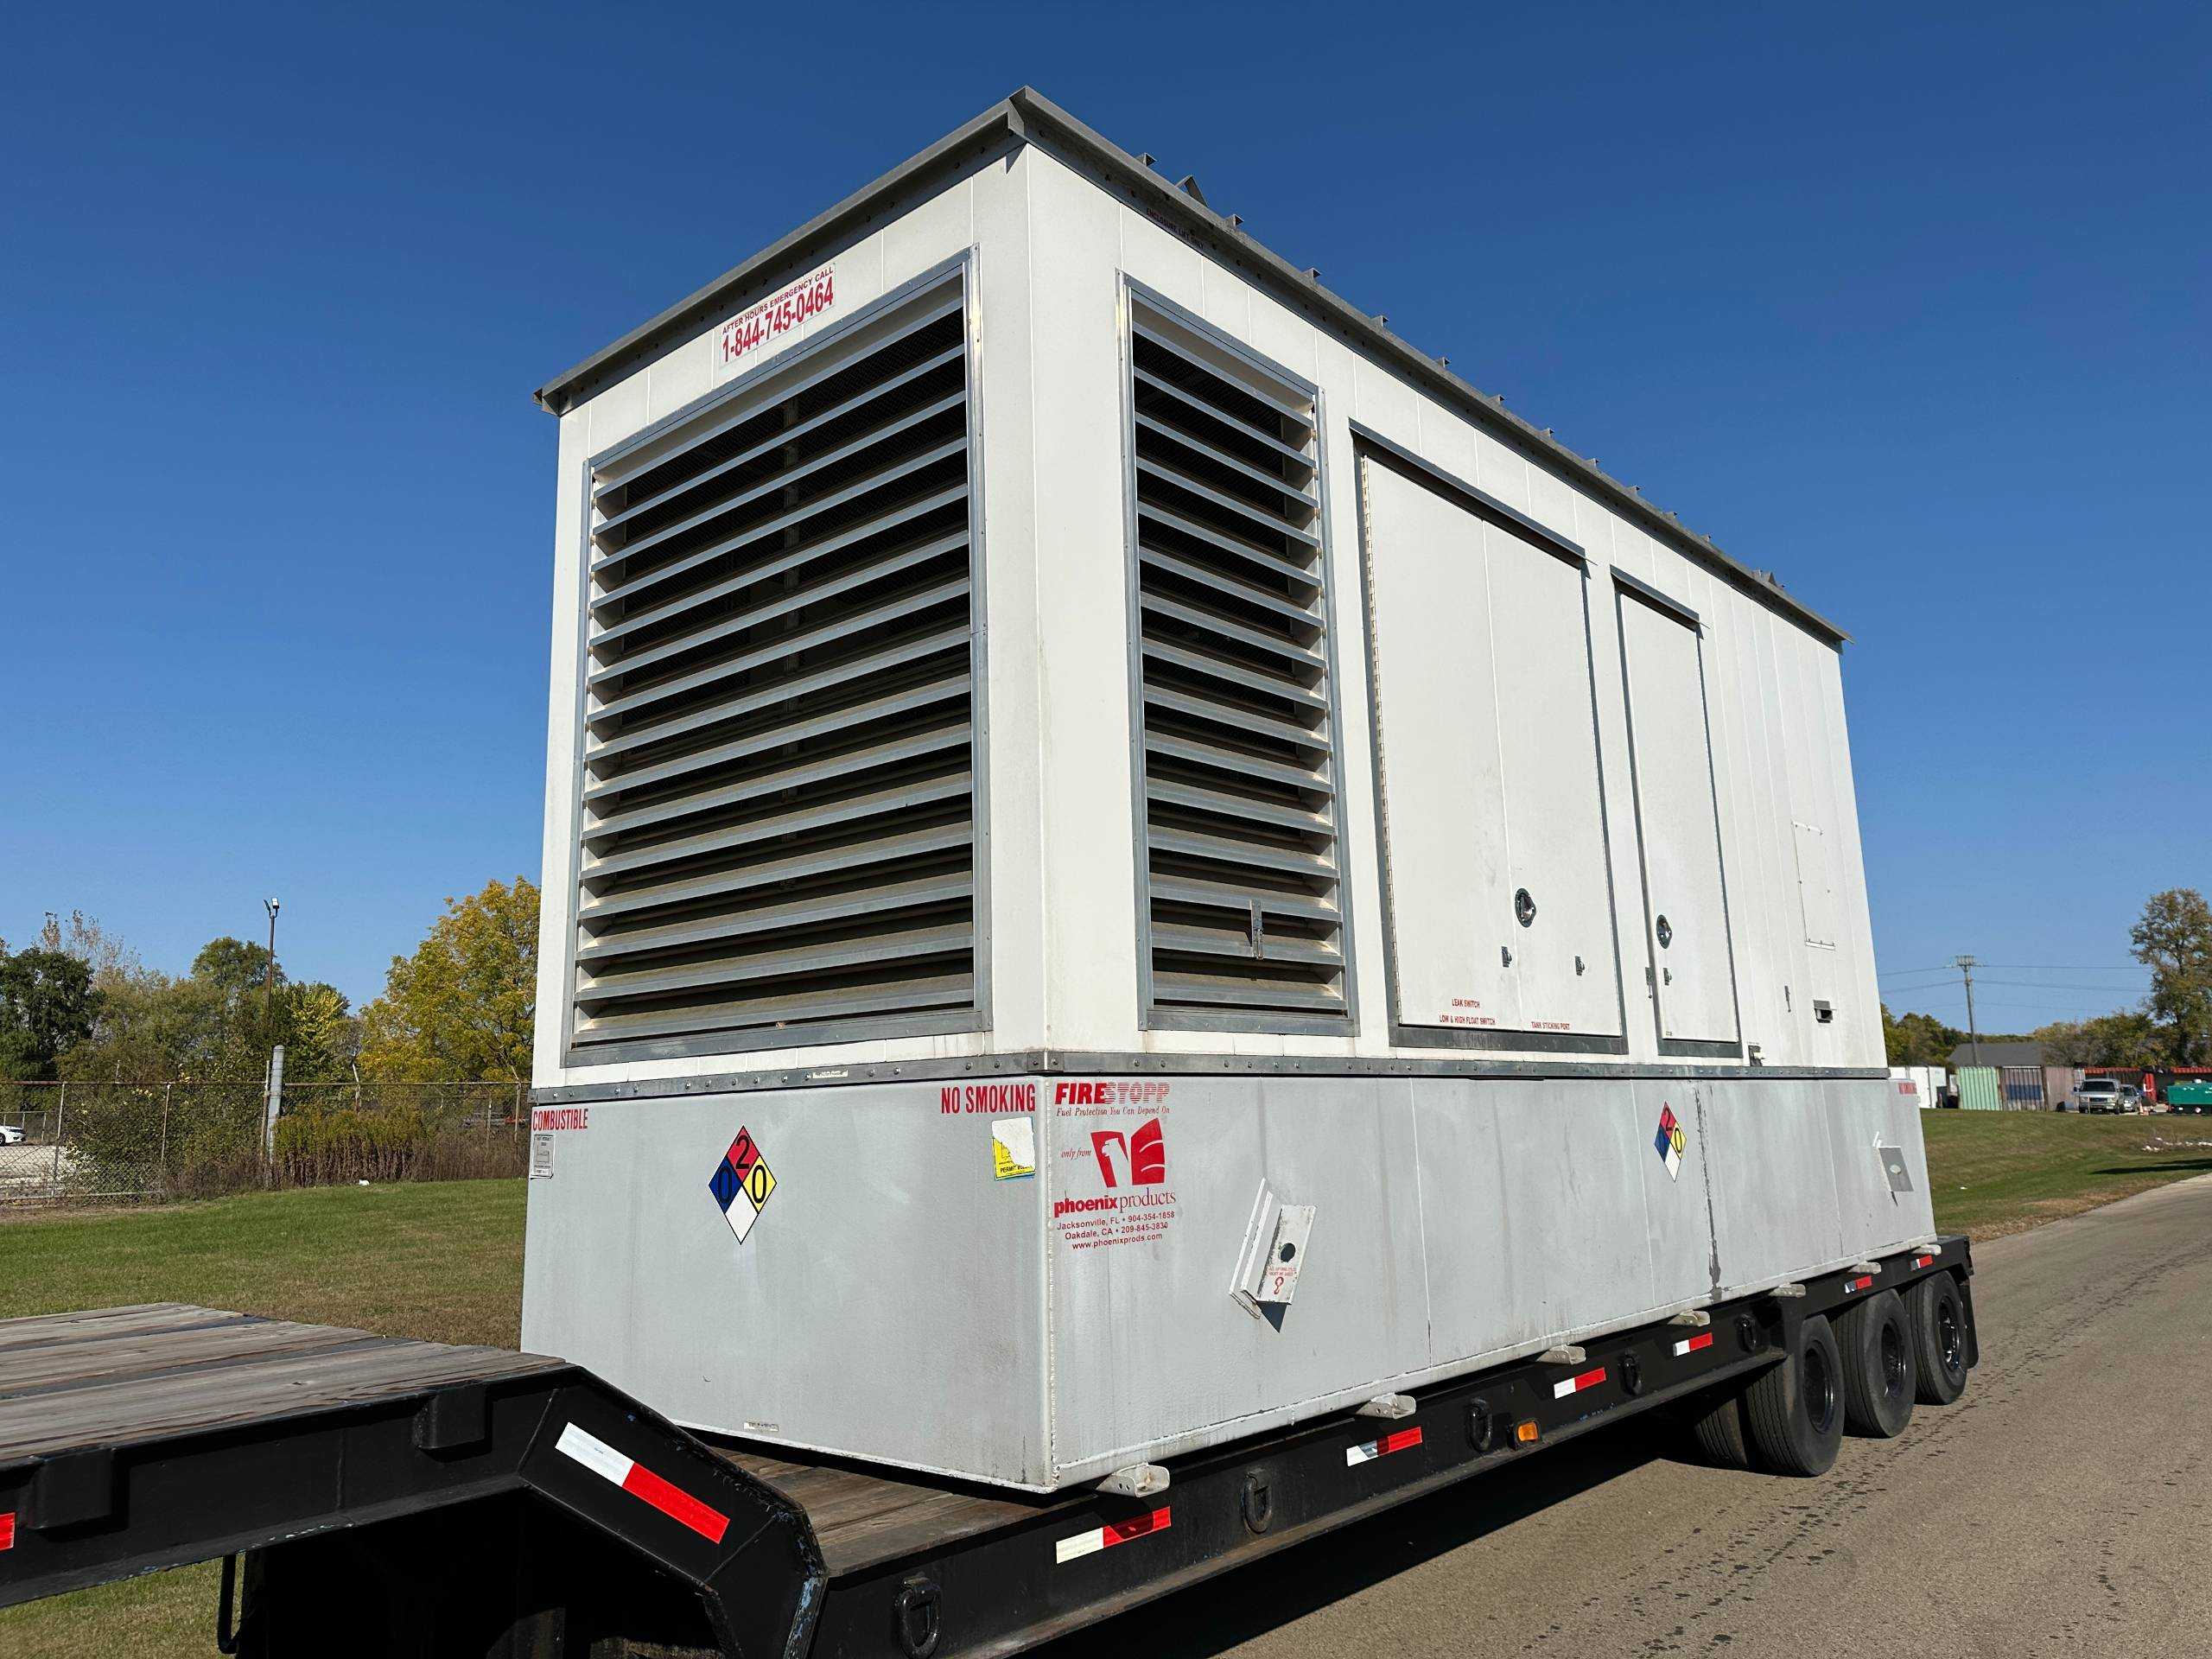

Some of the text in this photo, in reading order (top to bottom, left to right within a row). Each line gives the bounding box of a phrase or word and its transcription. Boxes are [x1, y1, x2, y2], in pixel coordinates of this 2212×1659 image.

[722, 266, 834, 334] AFTER HOURS EMERGENCY CALL
[722, 276, 834, 363] 1-844-745-0464
[1452, 998, 1480, 1008] LEAK SWITCH
[1439, 1014, 1449, 1023] LOW
[1454, 1015, 1465, 1024] HIGH
[1466, 1016, 1478, 1025] FLOAT
[1479, 1017, 1496, 1026] SWITCH
[941, 1084, 1036, 1114] NO SMOKING
[1054, 1082, 1170, 1105] FIRESTOPP
[532, 1108, 588, 1131] COMBUSTIBLE
[1056, 1107, 1071, 1116] Fuel
[1075, 1107, 1107, 1116] Protection
[1122, 1106, 1135, 1115] Can
[1138, 1106, 1159, 1116] Depend
[735, 1135, 750, 1169] 2
[1061, 1147, 1091, 1160] only from
[718, 1165, 767, 1205] 0 0
[1054, 1187, 1176, 1217] phoenix products
[1057, 1217, 1108, 1230] Jacksonville,
[1065, 1230, 1099, 1240] Oakdale,
[1071, 1233, 1163, 1249] www.phoenixprods.com
